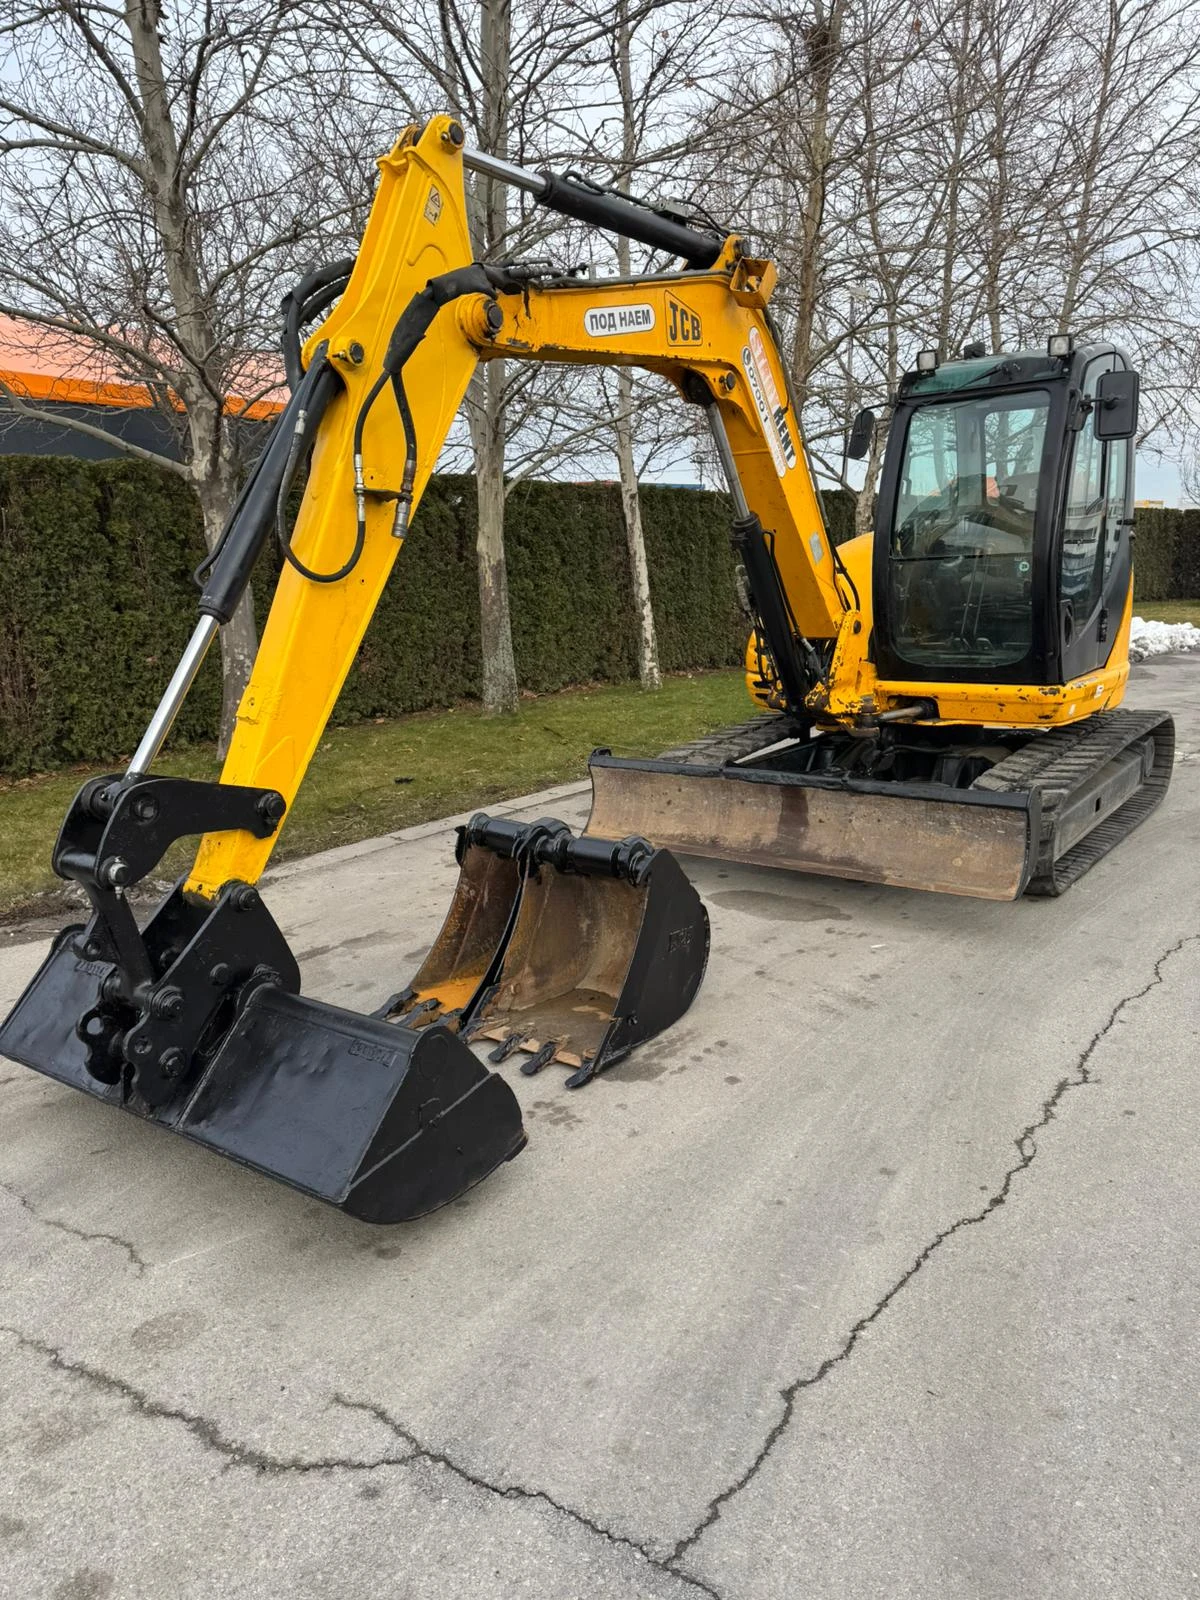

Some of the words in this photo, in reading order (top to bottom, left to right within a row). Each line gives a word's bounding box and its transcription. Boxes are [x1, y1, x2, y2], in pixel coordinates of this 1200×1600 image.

[589, 313, 617, 332] ПОД
[618, 309, 651, 328] НАЕМ
[669, 301, 701, 341] JCB
